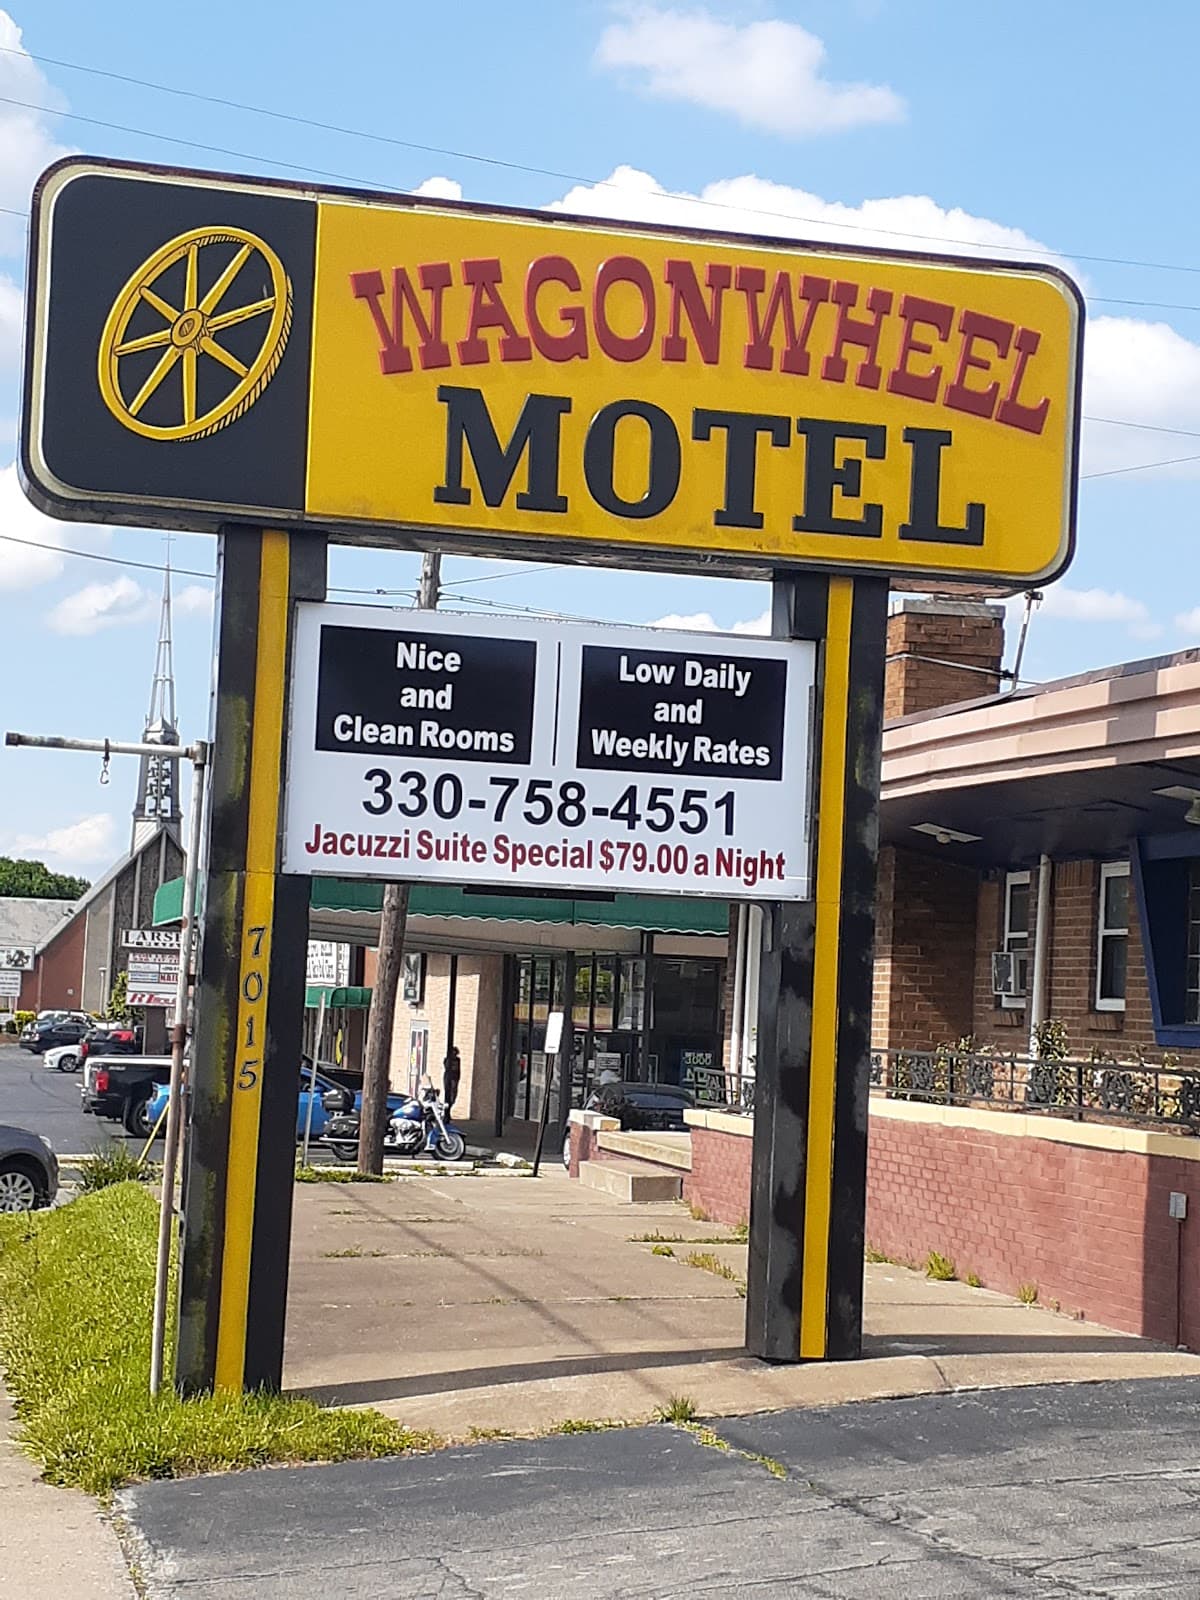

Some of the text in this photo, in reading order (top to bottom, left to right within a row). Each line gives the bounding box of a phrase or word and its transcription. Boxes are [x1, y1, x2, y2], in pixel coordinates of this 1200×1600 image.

[349, 255, 1051, 436] WAGONWHEEL
[433, 384, 986, 547] MOTEL
[396, 641, 462, 674] Nice
[618, 655, 752, 697] Low Daily
[400, 684, 453, 710] and
[653, 698, 703, 725] and
[333, 715, 515, 754] Clean Rooms
[590, 729, 771, 767] Weekly Rates
[362, 768, 736, 836] 330-758-4551
[305, 824, 786, 887] Jacuzzi Suite Special $79.00 a Night
[236, 926, 269, 1090] 7015
